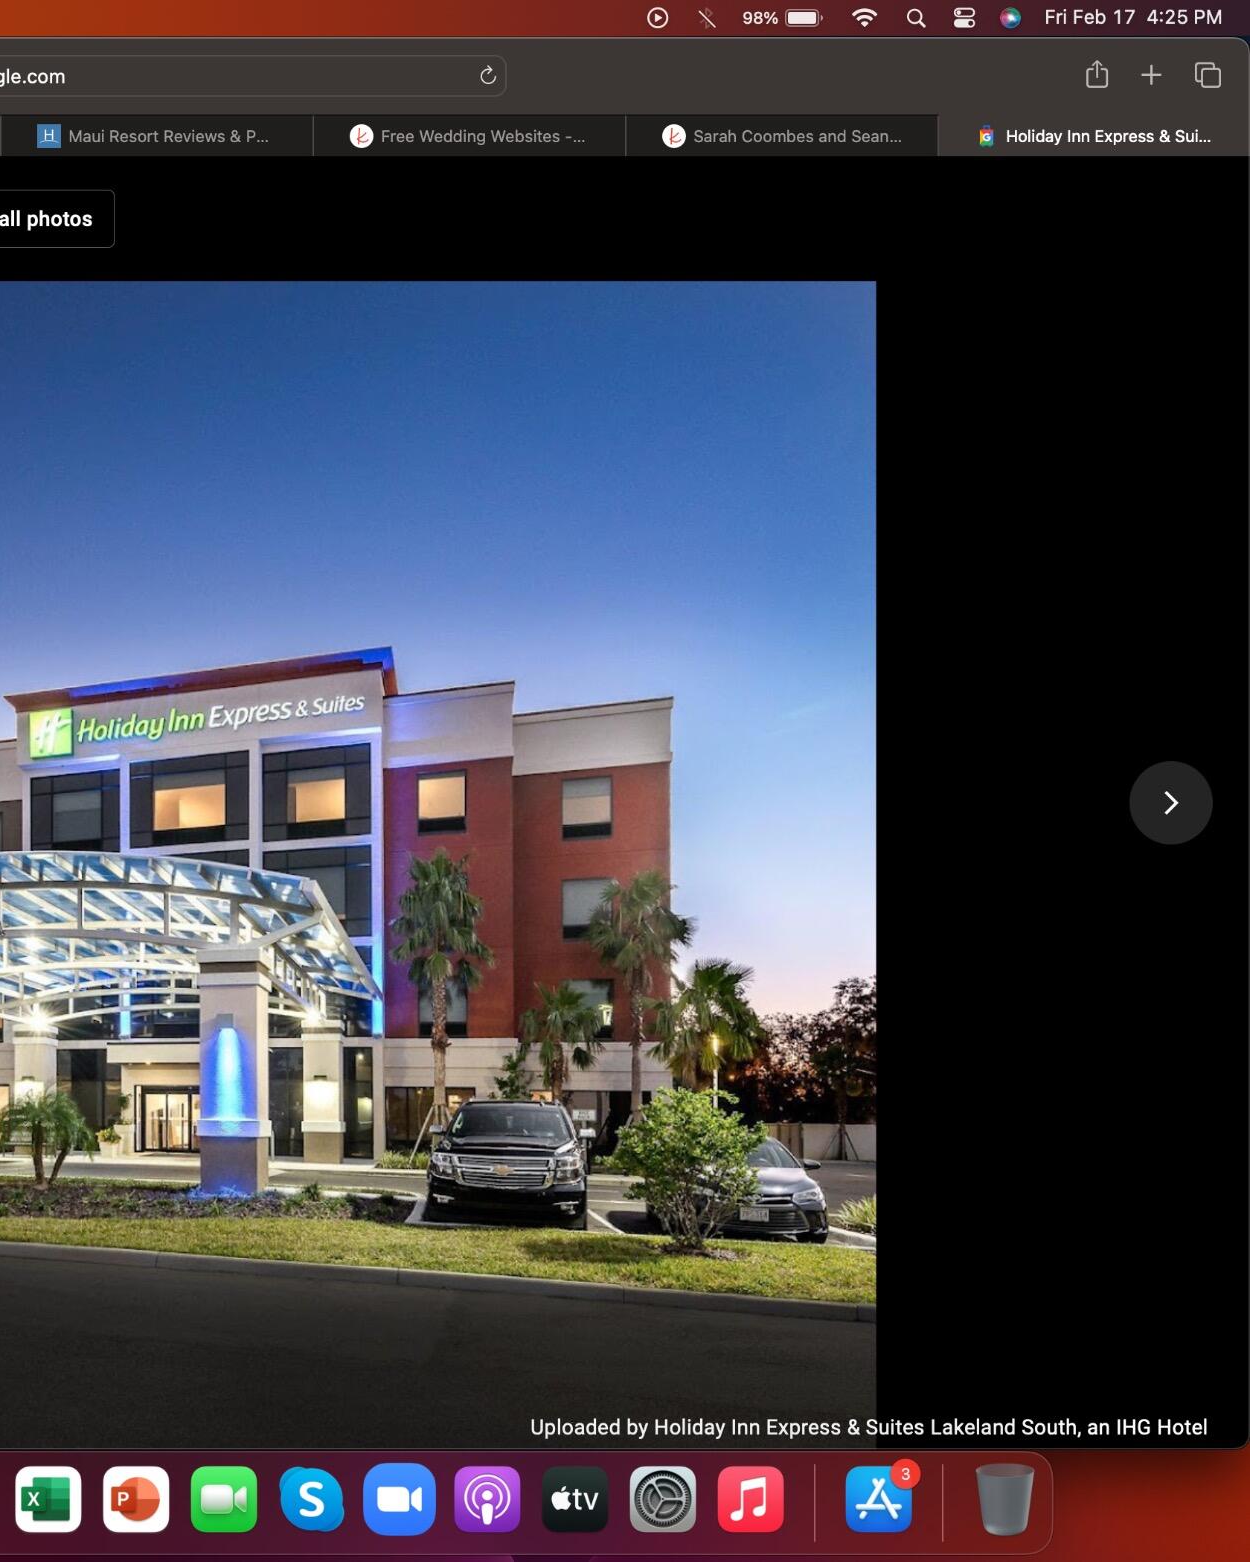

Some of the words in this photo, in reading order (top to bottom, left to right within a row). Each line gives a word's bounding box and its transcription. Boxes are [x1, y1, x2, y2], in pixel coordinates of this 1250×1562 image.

[742, 11, 779, 25] 98%
[1045, 8, 1067, 25] Fri
[1073, 8, 1107, 25] Feb
[1113, 9, 1136, 25] 17
[1146, 9, 1188, 25] 4:25
[1194, 9, 1222, 25] PM
[69, 129, 105, 143] Maui
[109, 129, 159, 143] Resort
[163, 129, 226, 143] Reviews
[229, 129, 242, 143] &
[381, 129, 415, 143] Free
[418, 128, 486, 146] Wedding
[490, 128, 561, 143] Websites
[693, 129, 737, 144] Sarah
[741, 129, 814, 144] Coombes
[818, 128, 847, 143] and
[1006, 128, 1064, 146] Holiday
[1066, 129, 1091, 143] Inn
[1094, 129, 1155, 146] Express
[1158, 128, 1172, 144] &
[26, 209, 93, 232] photos
[76, 712, 165, 744] Holiday
[168, 707, 205, 733] Inn
[208, 701, 293, 731] Express
[295, 699, 309, 718] &
[312, 695, 366, 716] Suites
[531, 1417, 621, 1440] Uploaded
[627, 1417, 649, 1440] by
[654, 1417, 726, 1440] Holiday
[732, 1418, 760, 1436] Inn
[766, 1418, 841, 1440] Express
[847, 1418, 861, 1436] &
[865, 1418, 925, 1436] Suites
[931, 1417, 1016, 1436] Lakeland
[1021, 1417, 1082, 1438] South,
[1087, 1422, 1110, 1436] an
[1117, 1418, 1151, 1436] IHG
[1157, 1417, 1208, 1436] Hotel
[901, 1467, 911, 1481] 3
[27, 1491, 40, 1507] X
[117, 1491, 130, 1507] P
[299, 1481, 325, 1518] S
